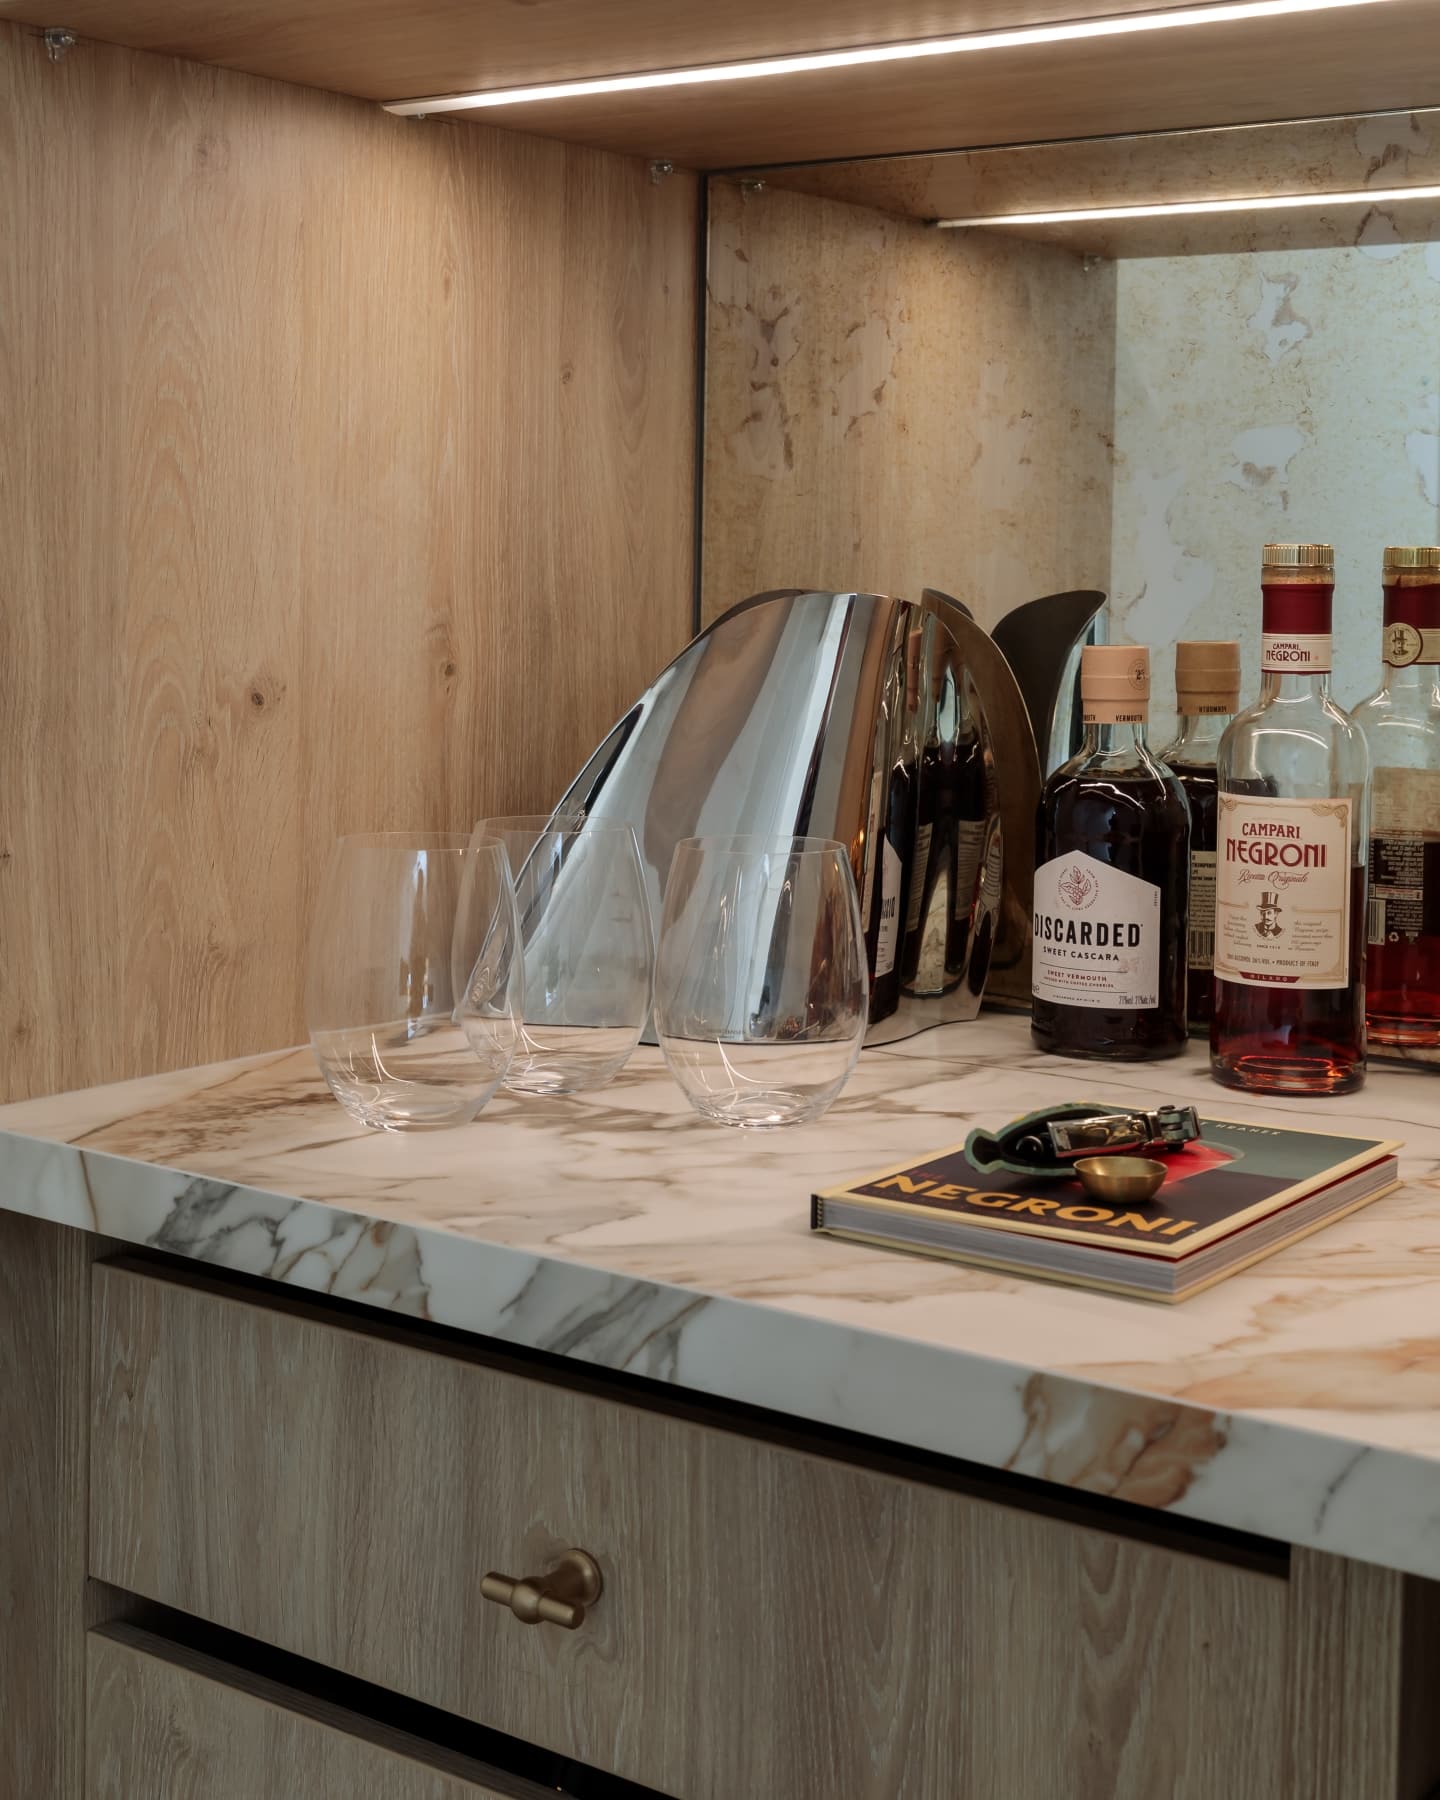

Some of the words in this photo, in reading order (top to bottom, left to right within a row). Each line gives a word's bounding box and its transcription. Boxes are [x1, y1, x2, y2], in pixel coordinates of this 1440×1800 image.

[1266, 650, 1310, 662] NEGRONI
[1115, 714, 1143, 722] VERMOUTH
[1242, 822, 1301, 839] CAMPARI
[1226, 838, 1326, 868] NEGRONI
[1035, 913, 1141, 947] DISCARDED
[1043, 946, 1067, 957] SWEET
[1070, 951, 1120, 961] CASCARA
[1047, 969, 1065, 978] SWEET
[1067, 973, 1107, 982] VERMOUTH
[877, 1174, 1198, 1236] NEGRONI
